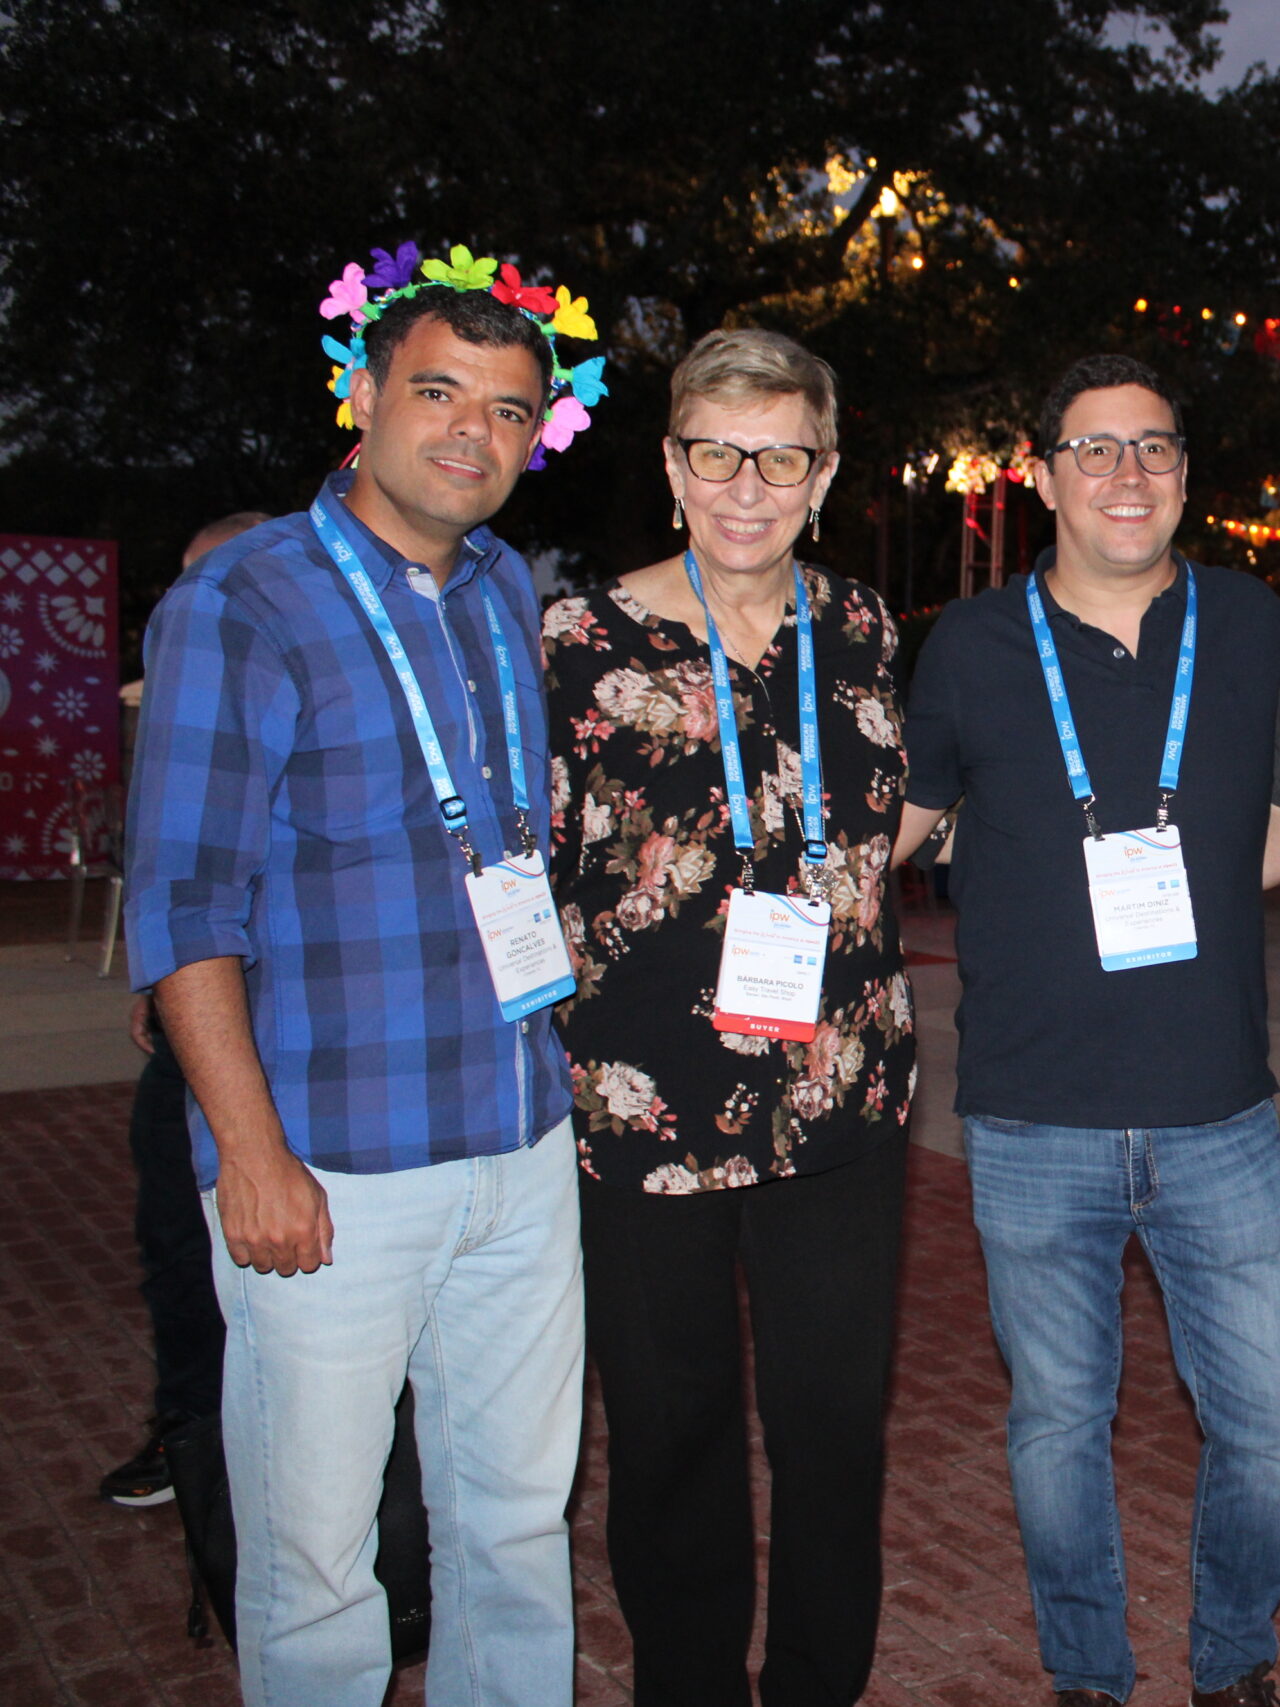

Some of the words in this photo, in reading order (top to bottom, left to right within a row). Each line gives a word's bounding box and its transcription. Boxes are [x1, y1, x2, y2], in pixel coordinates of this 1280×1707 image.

[332, 541, 352, 562] ipw
[801, 692, 815, 712] ipw
[1061, 721, 1074, 740] ipw
[1167, 740, 1182, 760] ipw
[806, 784, 817, 804] ipw
[1124, 846, 1144, 858] ipw
[500, 879, 517, 893] ipw
[1148, 899, 1169, 908] DINIZ
[769, 909, 790, 922] ipw
[510, 931, 536, 946] RENATO
[506, 938, 545, 959] GONCALVES
[1126, 951, 1173, 963] EXHIBITOR
[737, 976, 774, 986] BARBARA
[776, 980, 804, 990] PICOLO
[521, 989, 558, 1010] EXHIBITOR
[750, 1024, 780, 1033] BUYER
